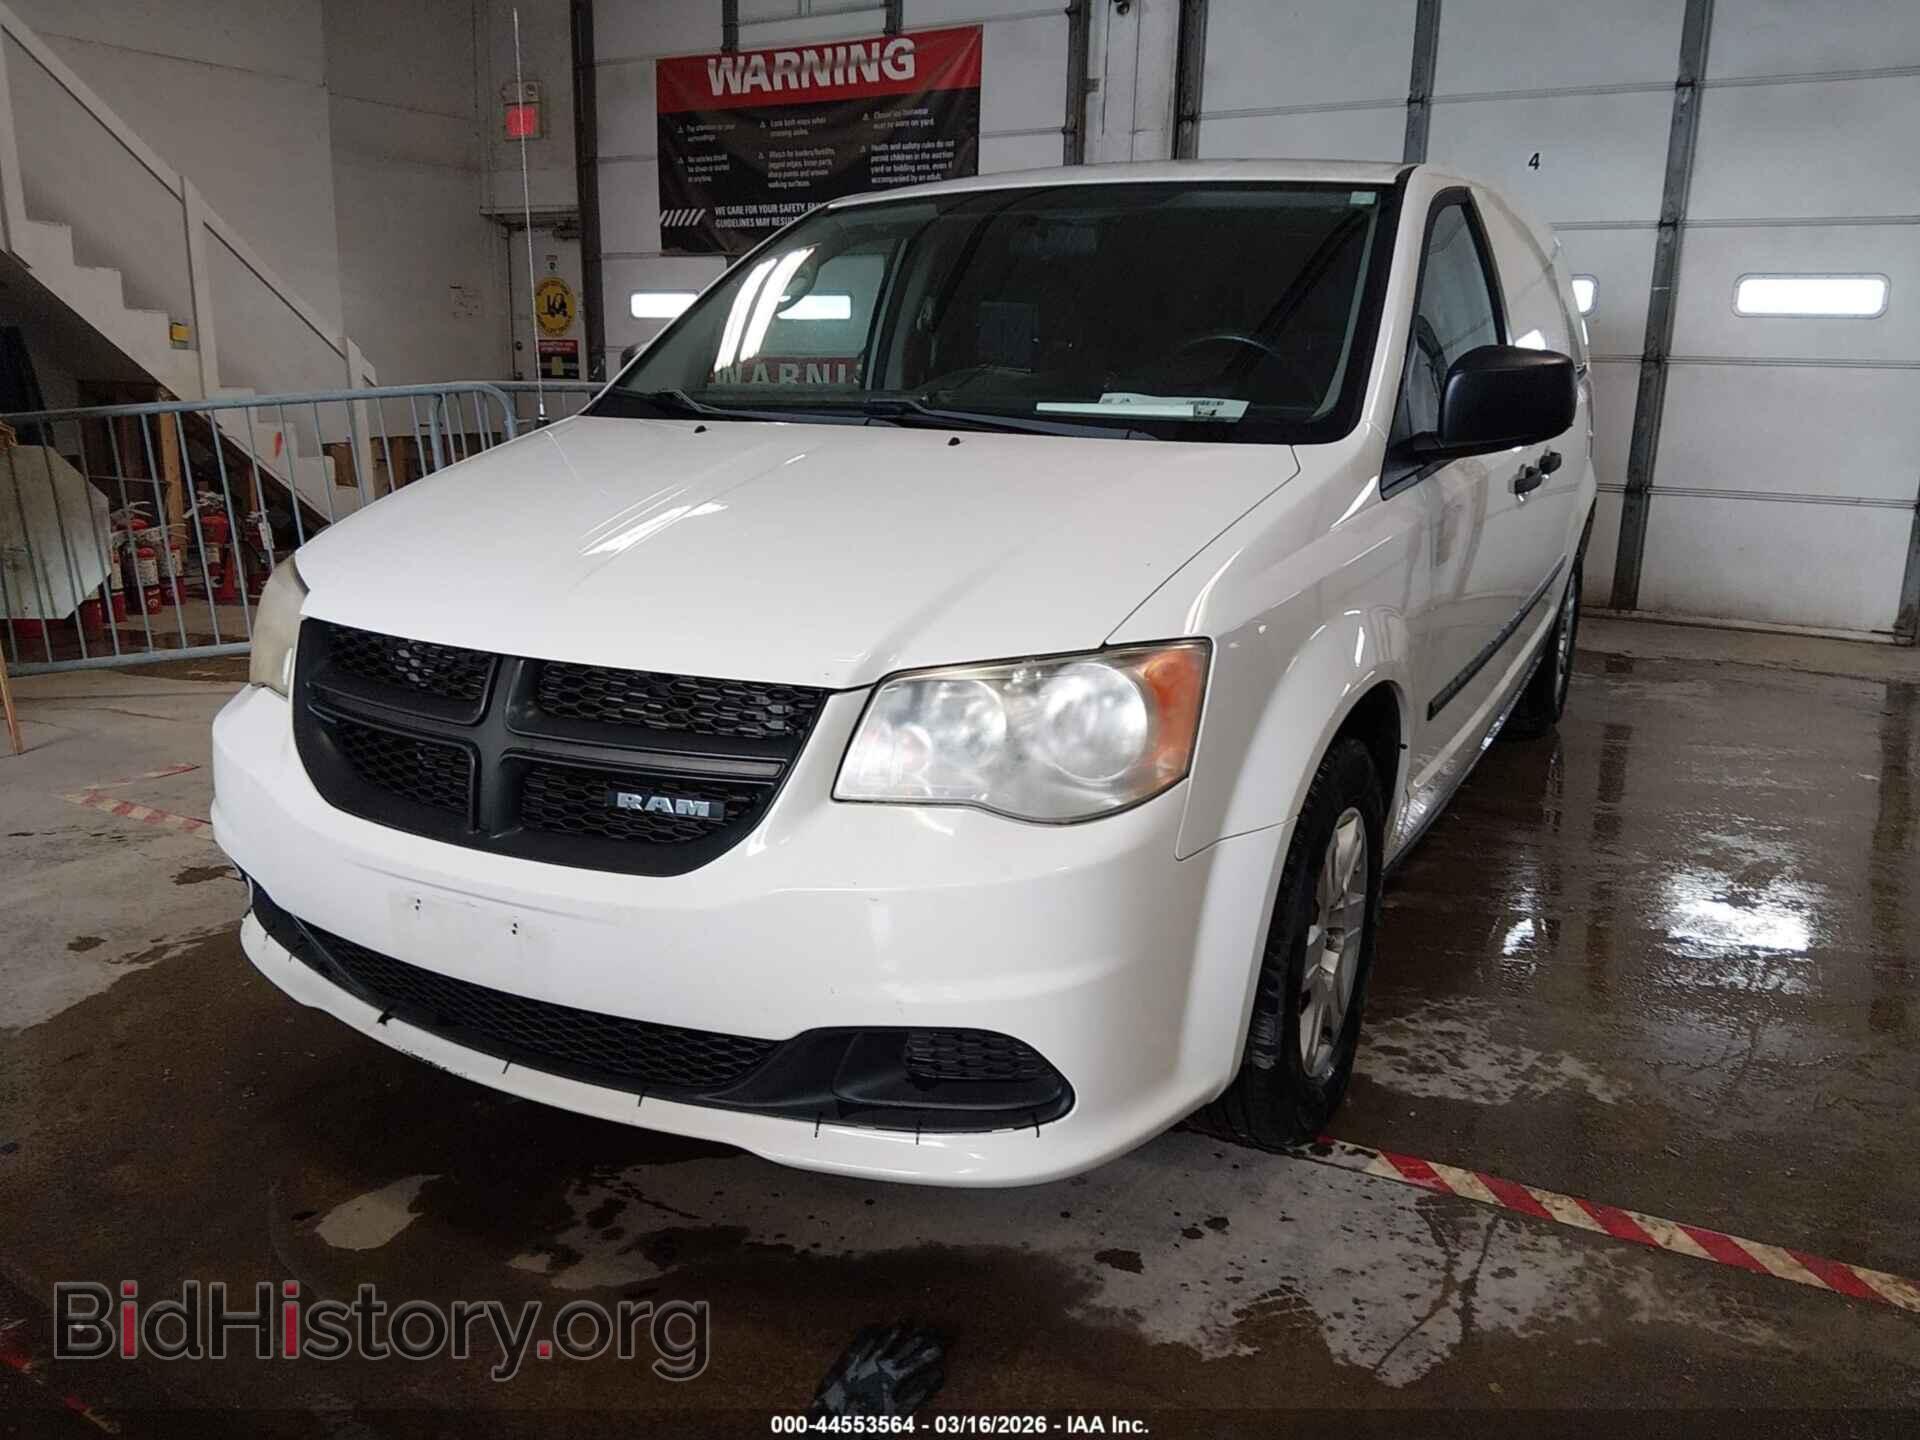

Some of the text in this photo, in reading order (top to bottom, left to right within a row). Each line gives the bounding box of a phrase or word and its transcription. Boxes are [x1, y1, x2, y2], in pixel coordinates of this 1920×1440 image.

[707, 38, 916, 96] WARNING
[1528, 152, 1540, 170] 4
[727, 205, 744, 214] CARE
[745, 204, 758, 214] FOR
[759, 203, 778, 213] YOUR
[714, 360, 862, 385] WARNI
[617, 792, 710, 817] RAM
